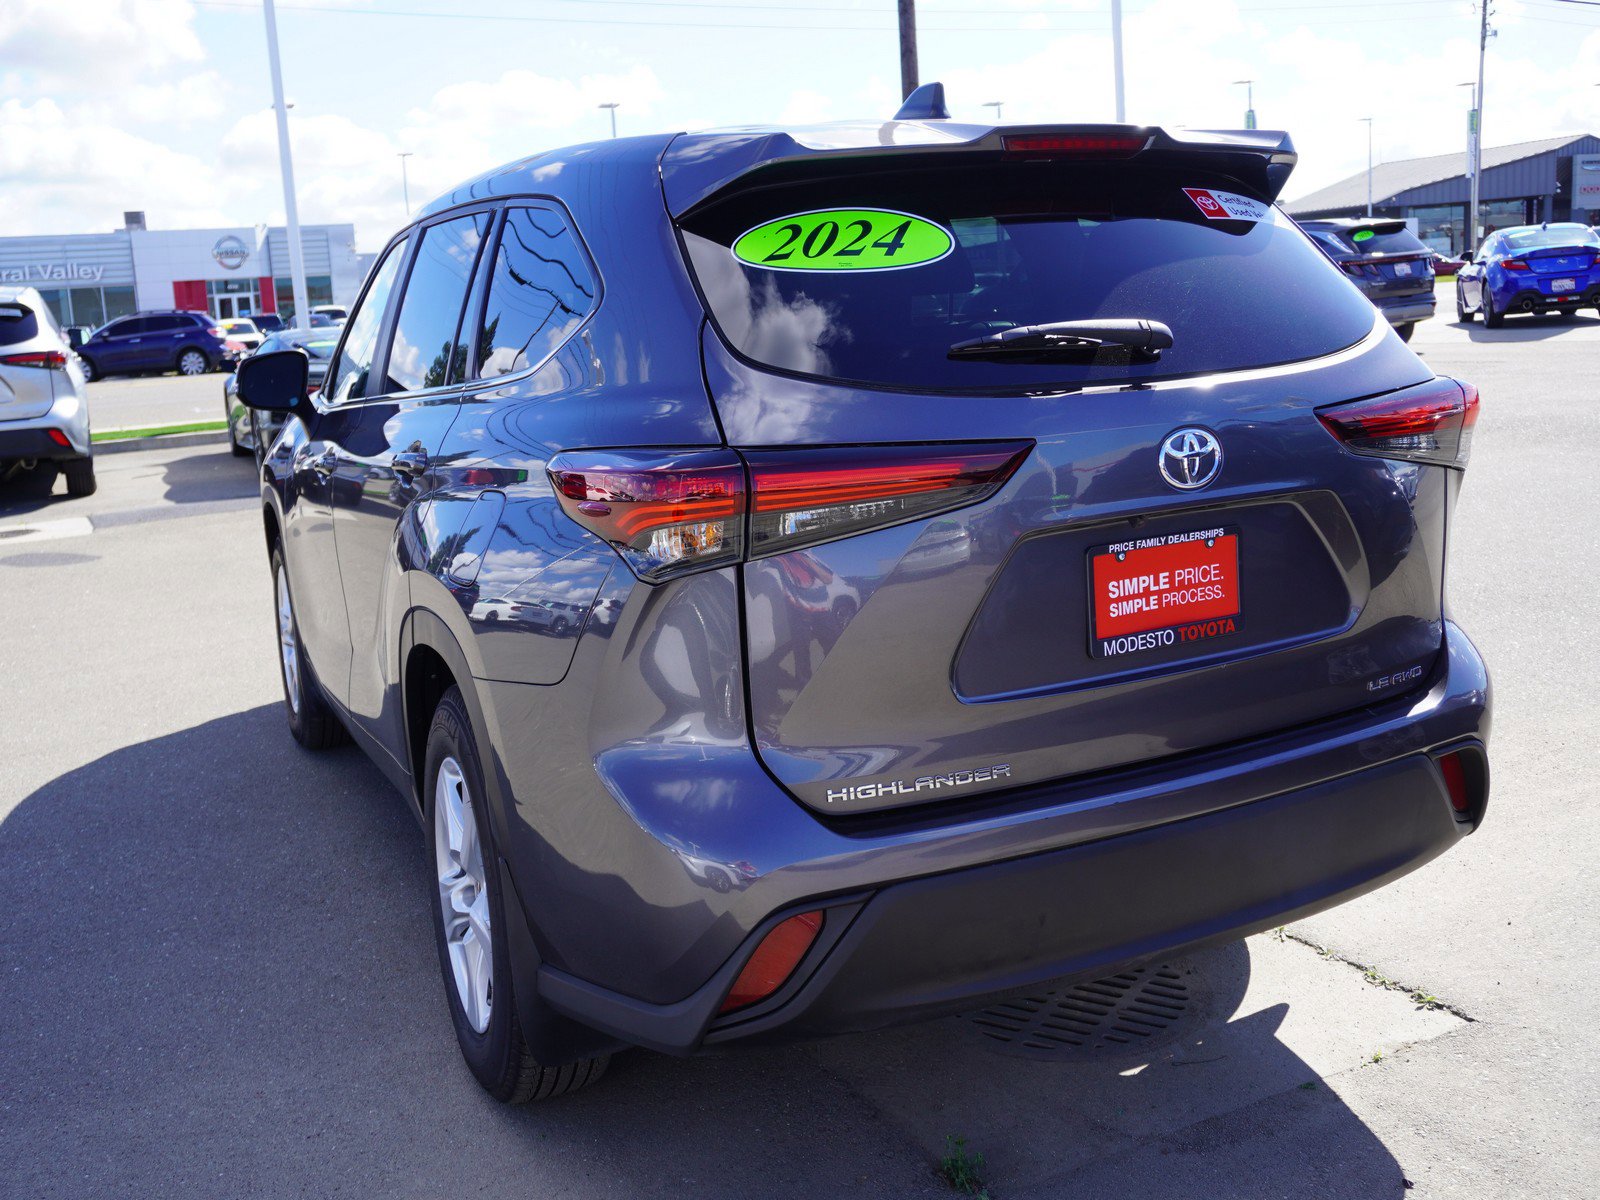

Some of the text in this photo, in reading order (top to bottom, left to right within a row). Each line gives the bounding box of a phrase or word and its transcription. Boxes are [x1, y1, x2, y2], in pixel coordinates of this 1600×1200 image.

[1227, 206, 1252, 218] Used
[761, 219, 913, 263] 2024
[38, 262, 104, 281] Valley
[1108, 527, 1225, 554] PRICE FAMILY DEALERSHIPS
[1108, 563, 1225, 599] SIMPLE PRICE.
[1109, 584, 1226, 618] SIMPLE PROCESS.
[1103, 618, 1236, 657] MODESTO TOYOTA
[1367, 665, 1422, 692] LE AWD
[826, 763, 1012, 803] HIGHLANDER
